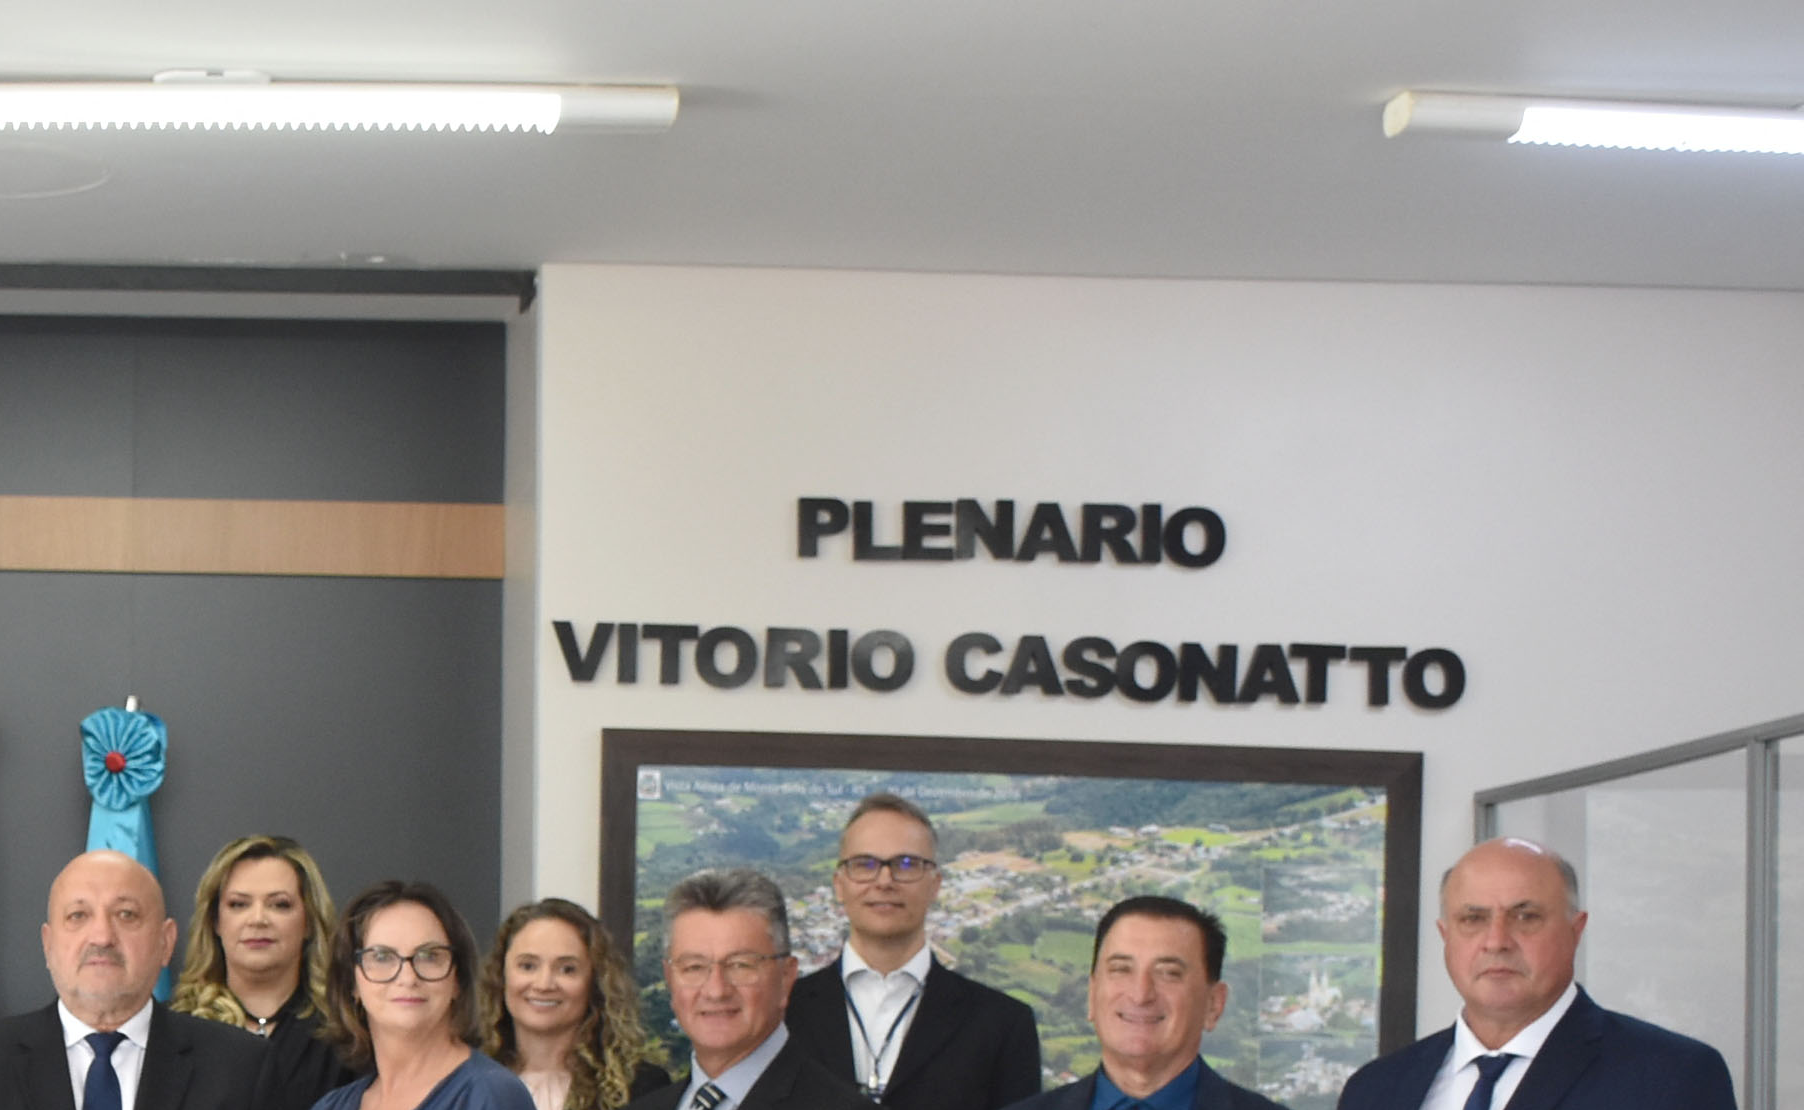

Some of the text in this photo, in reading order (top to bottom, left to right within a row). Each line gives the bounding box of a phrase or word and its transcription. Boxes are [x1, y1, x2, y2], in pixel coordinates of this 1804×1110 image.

[797, 497, 1227, 570] PLENARIO
[552, 620, 1466, 710] VITORIO CASONATTO
